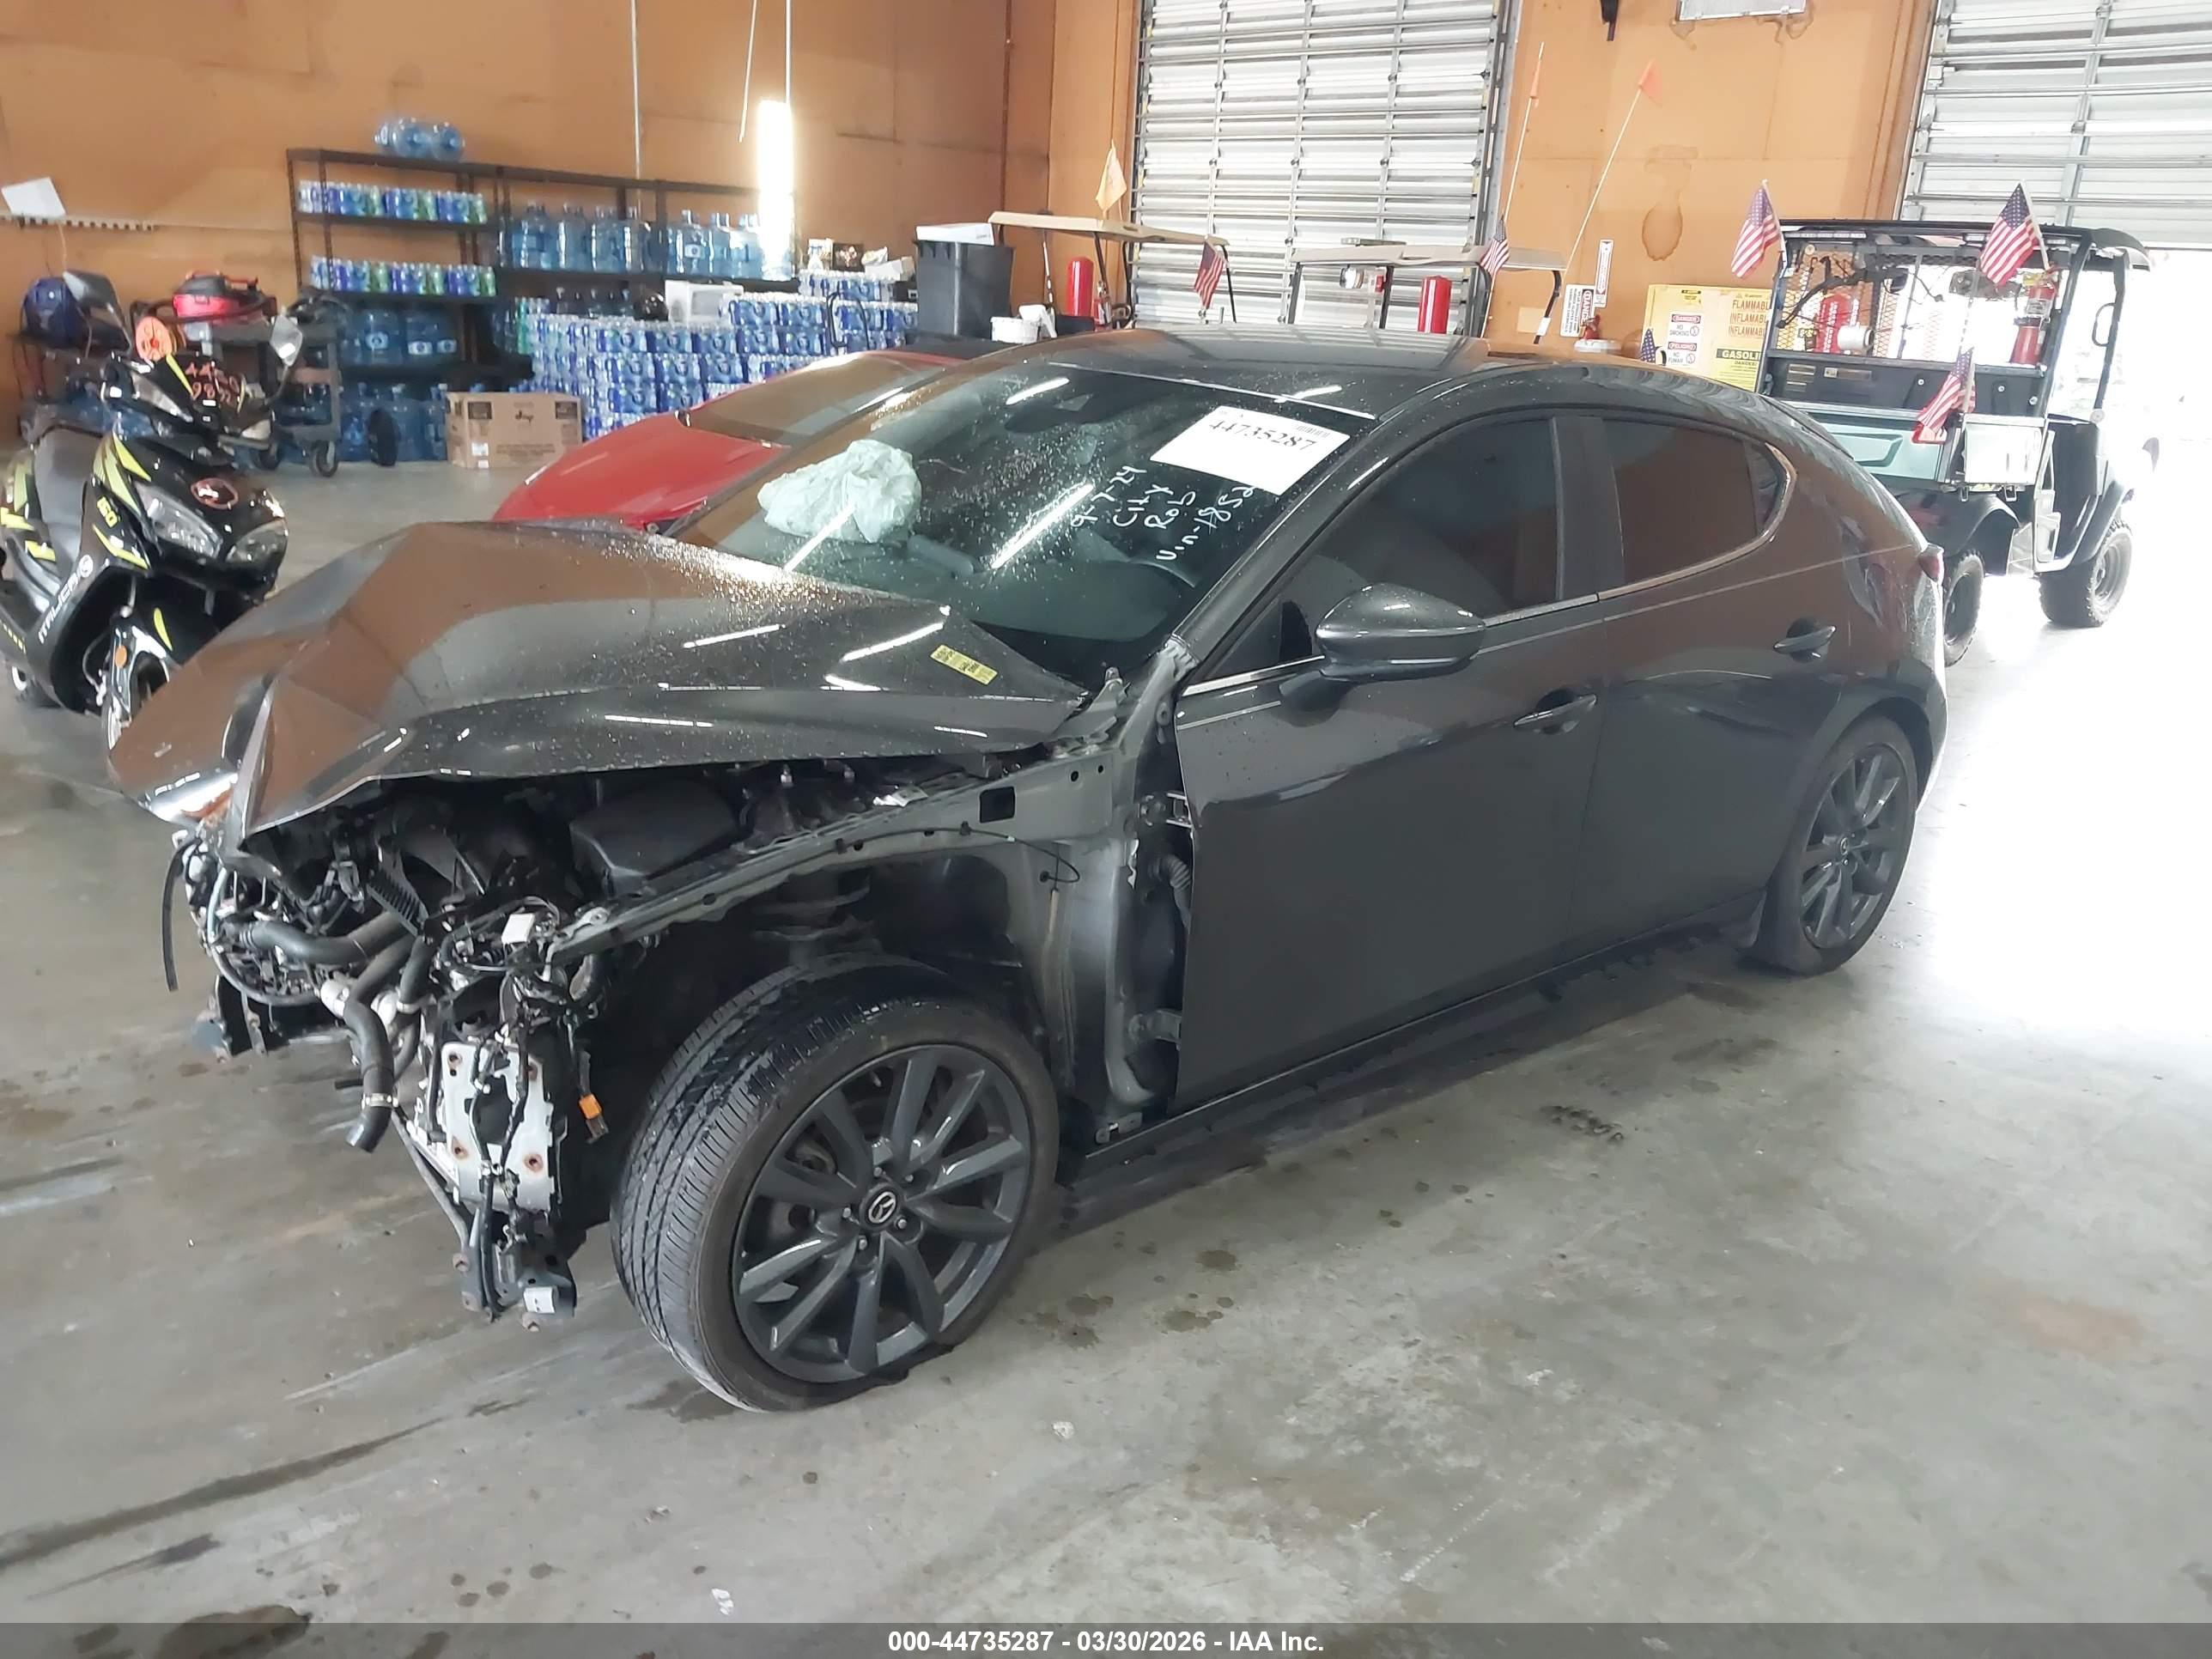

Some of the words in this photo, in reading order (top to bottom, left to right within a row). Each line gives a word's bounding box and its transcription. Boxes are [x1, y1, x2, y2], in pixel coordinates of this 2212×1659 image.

[1580, 293, 1591, 325] DANG
[1732, 300, 1770, 310] FLAMMABL
[1729, 313, 1767, 324] INFLAMABL
[1728, 325, 1764, 336] INFLAMMAB
[1722, 349, 1761, 361] GASOLI
[1209, 420, 1317, 451] 44735287
